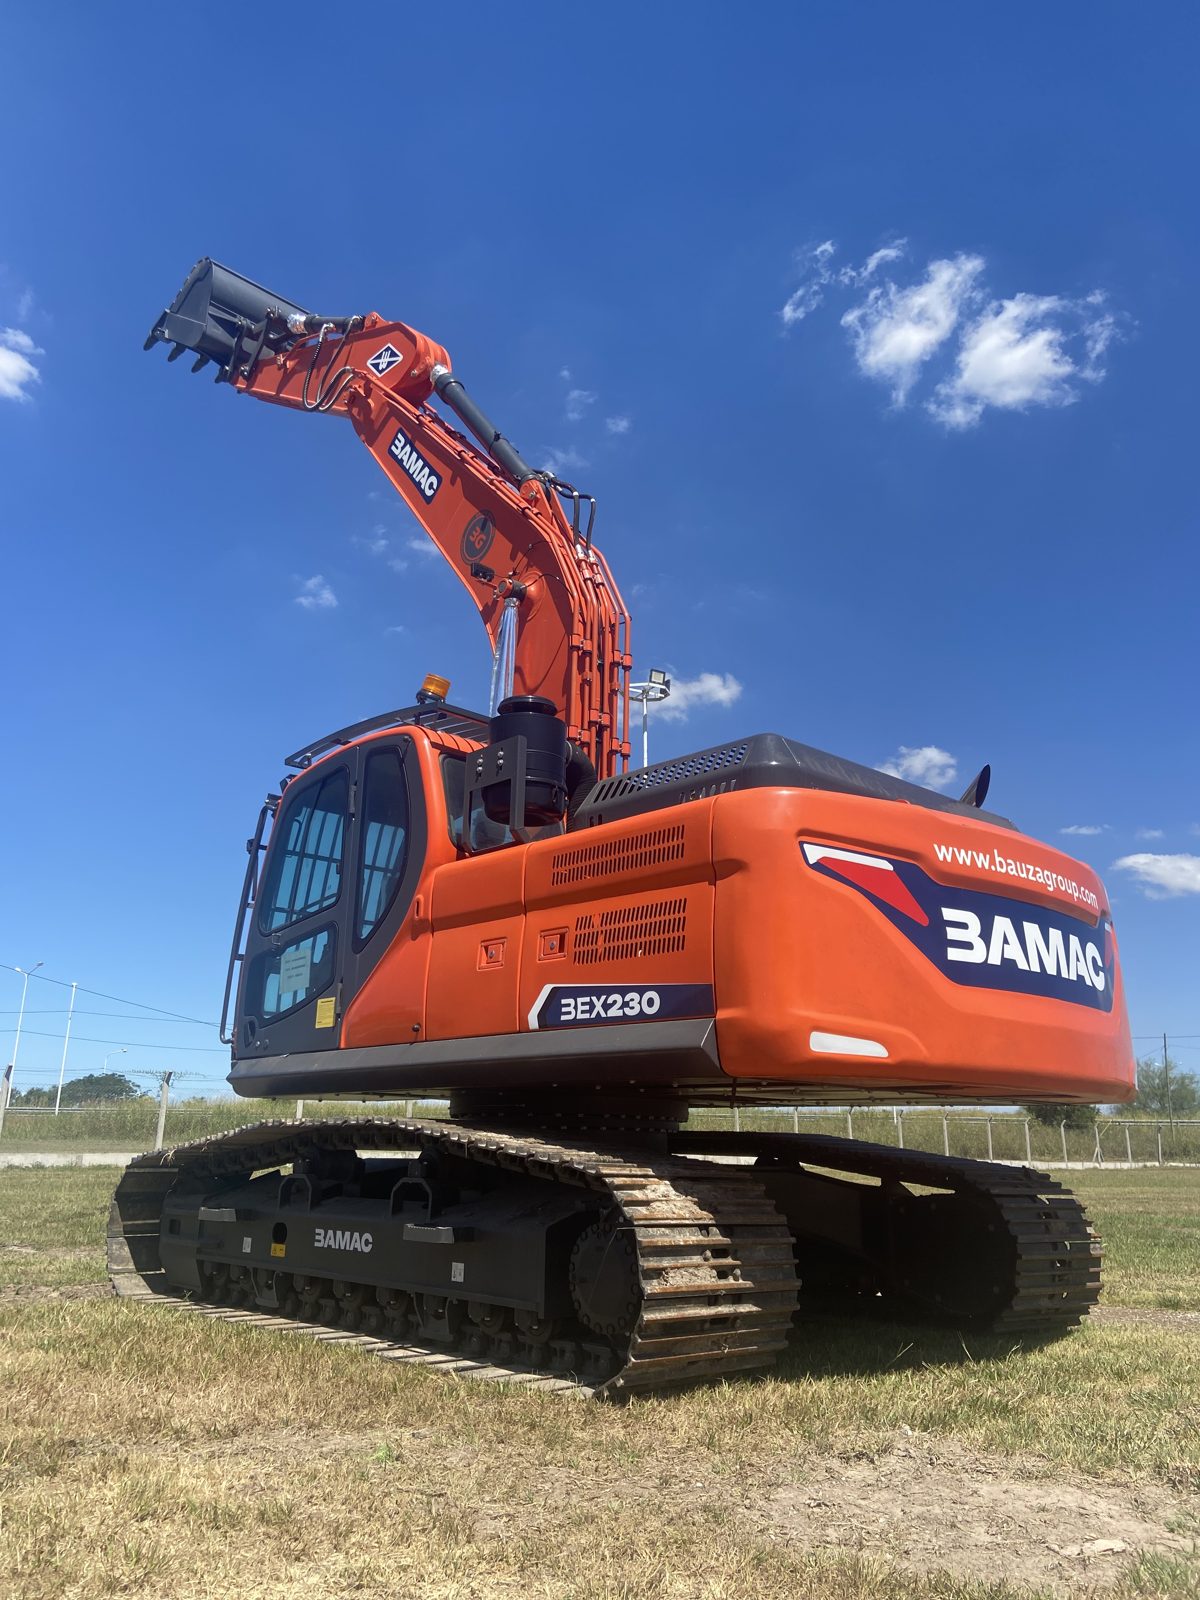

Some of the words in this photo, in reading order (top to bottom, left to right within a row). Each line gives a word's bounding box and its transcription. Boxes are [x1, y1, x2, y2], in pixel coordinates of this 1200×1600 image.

[391, 433, 437, 496] BAMAC
[933, 843, 1098, 909] www.bauzagroup.com
[941, 907, 1105, 991] BAMAC
[560, 991, 660, 1020] BEX230
[314, 1228, 373, 1253] BAMAC
